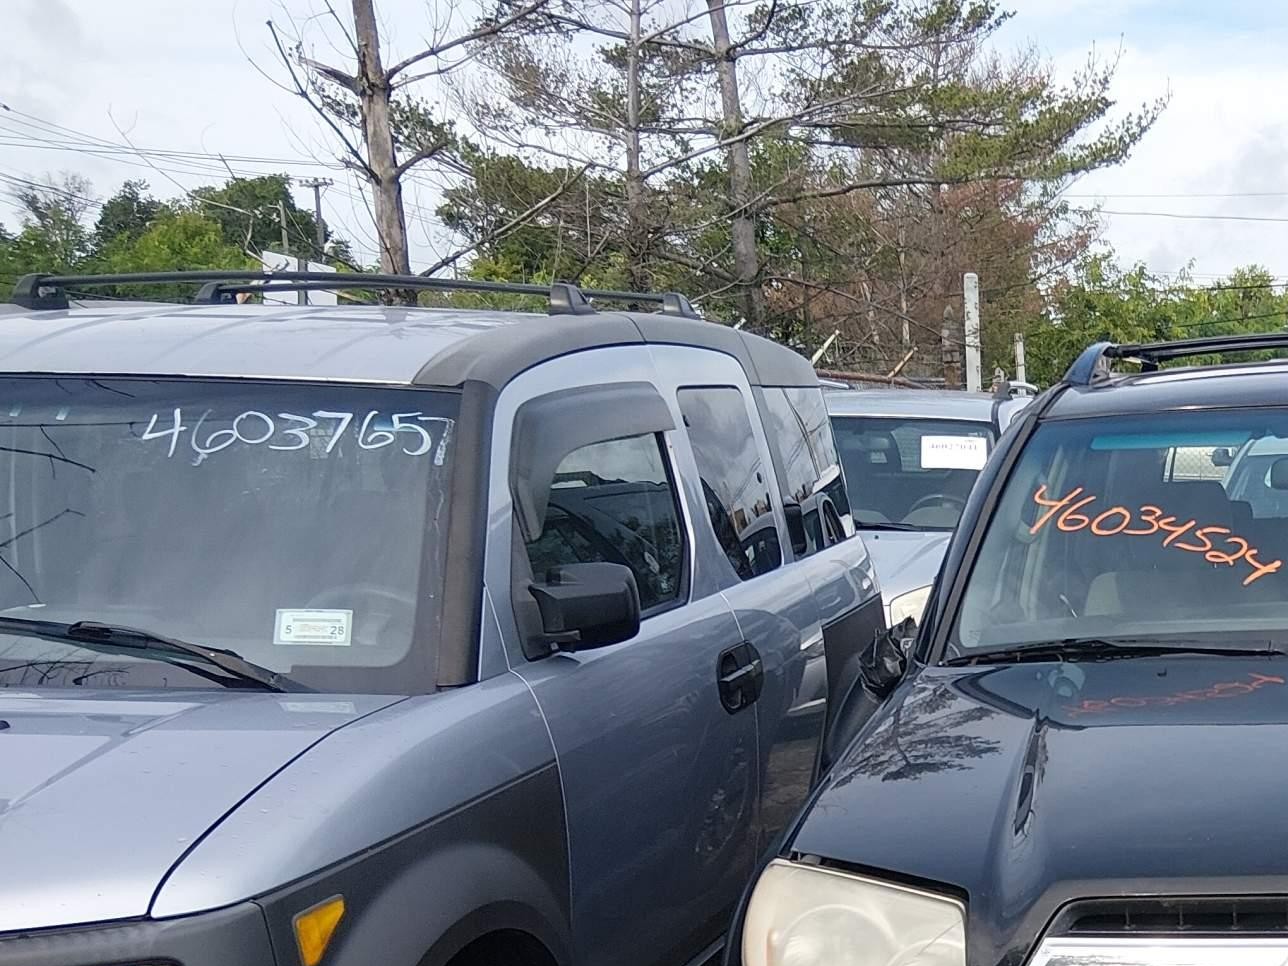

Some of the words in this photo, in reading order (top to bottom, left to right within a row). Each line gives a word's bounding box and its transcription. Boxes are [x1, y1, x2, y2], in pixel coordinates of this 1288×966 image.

[142, 407, 455, 466] 46037657
[1028, 484, 1283, 586] 46034524
[329, 625, 345, 635] 28
